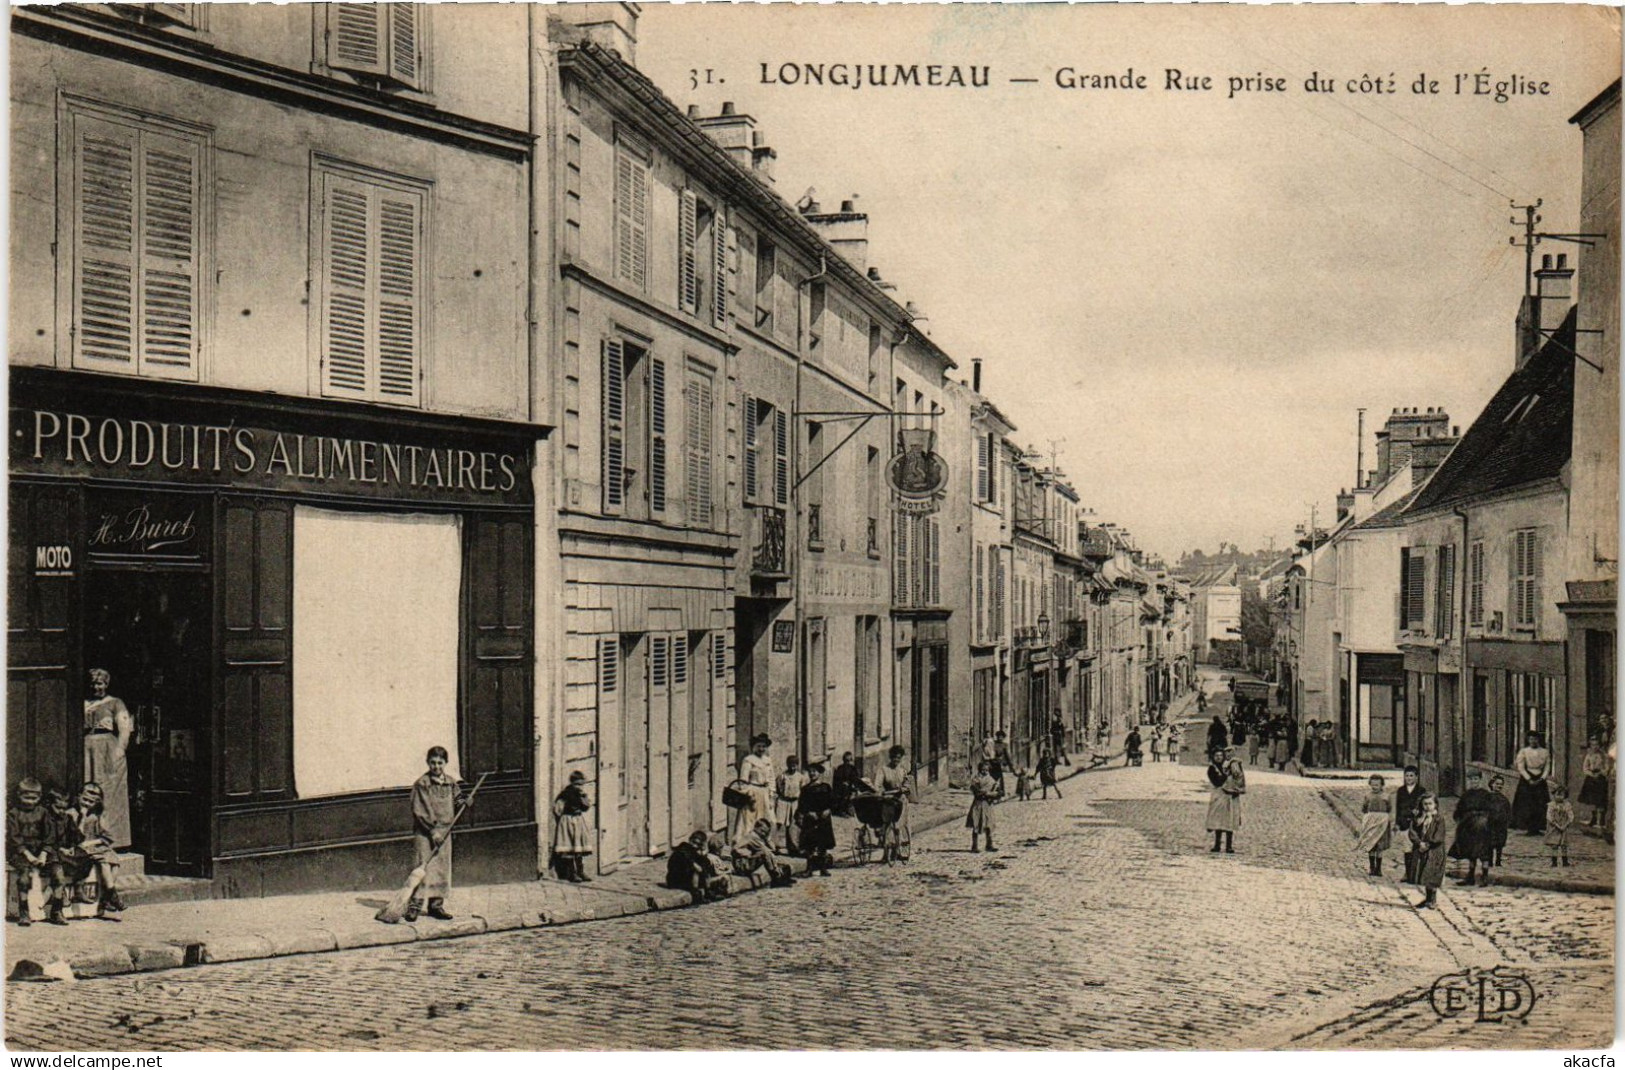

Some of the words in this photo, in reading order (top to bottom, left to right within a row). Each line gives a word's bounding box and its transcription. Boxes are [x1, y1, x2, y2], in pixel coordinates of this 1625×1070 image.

[34, 411, 256, 472] PRODUITS
[266, 433, 515, 491] ALIMENTAIRES
[901, 500, 932, 510] HOTEL
[36, 545, 72, 569] MOTO
